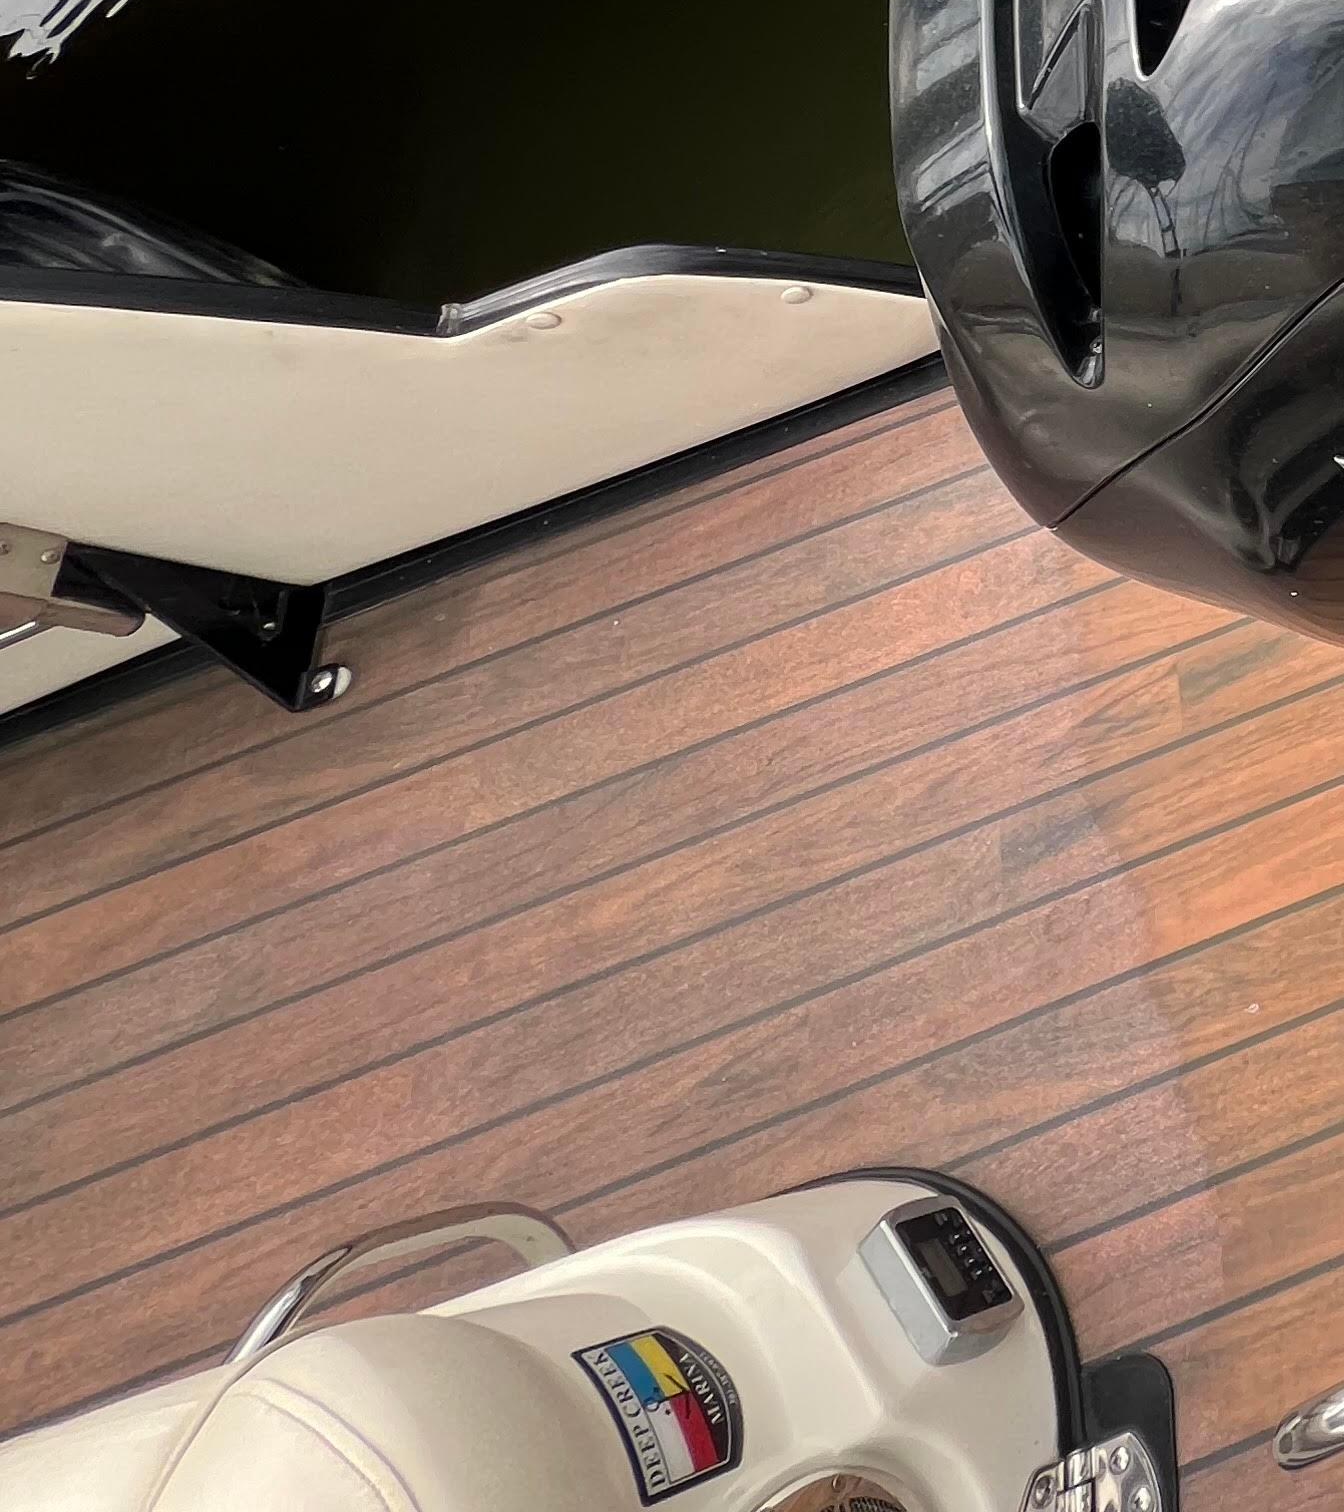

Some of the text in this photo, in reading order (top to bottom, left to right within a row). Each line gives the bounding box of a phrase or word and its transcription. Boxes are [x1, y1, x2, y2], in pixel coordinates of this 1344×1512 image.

[586, 1351, 666, 1488] DEEP CREEK
[679, 1352, 725, 1426] MARINA
